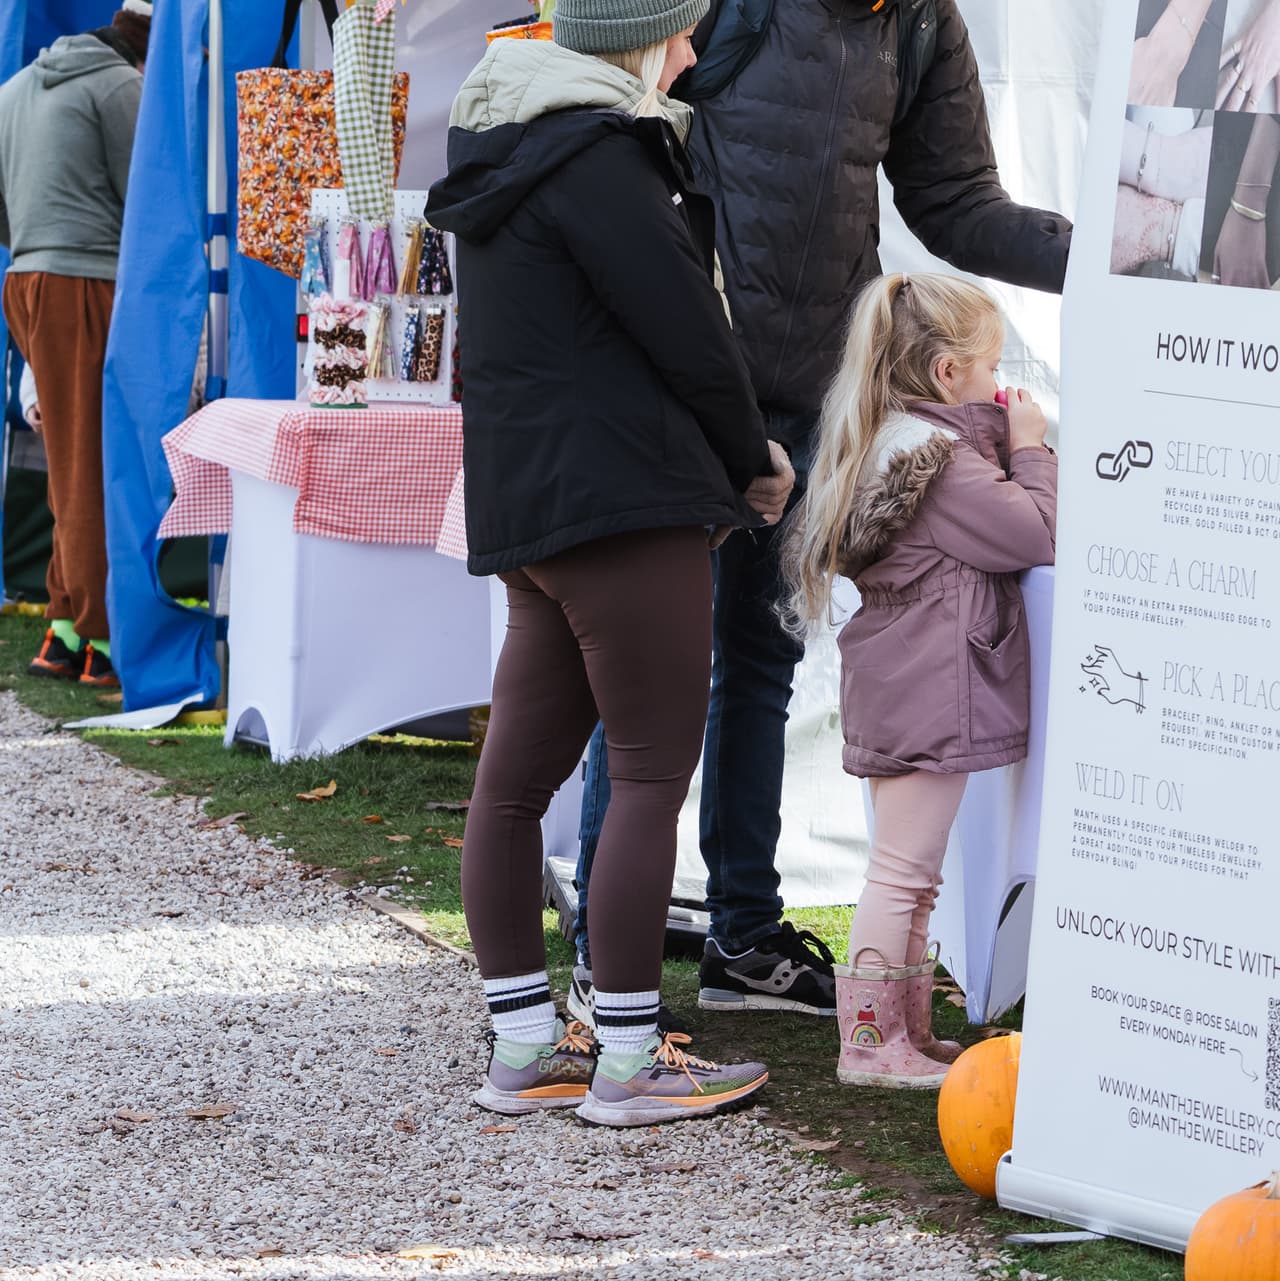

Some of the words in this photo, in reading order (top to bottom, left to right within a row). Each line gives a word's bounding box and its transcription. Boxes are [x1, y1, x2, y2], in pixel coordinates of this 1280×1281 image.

[1156, 332, 1210, 364] HOW
[1216, 338, 1234, 367] IT
[1164, 439, 1232, 477] SELECT
[1087, 543, 1158, 583] CHOOSE
[1164, 557, 1180, 587] A
[1188, 559, 1256, 600] CHARM
[1162, 660, 1203, 697] PICK
[1209, 671, 1224, 702] A
[1074, 760, 1125, 800] WELD
[1131, 773, 1150, 805] IT
[1155, 779, 1184, 812] ON
[1056, 906, 1125, 943] UNLOCK
[1129, 922, 1177, 955] YOUR
[1182, 935, 1232, 968] STYLE
[1091, 985, 1118, 1003] BOOK
[1120, 992, 1147, 1010] YOUR
[1149, 999, 1181, 1019] SPACE
[1183, 1008, 1193, 1025] @
[1195, 1011, 1222, 1029] ROSE
[1224, 1018, 1257, 1038] SALON
[1119, 1015, 1150, 1034] EVERY
[1152, 1024, 1196, 1046] MONDAY
[1199, 1036, 1225, 1054] HERE
[1128, 1106, 1264, 1156] @MANTHJEWELLERY
